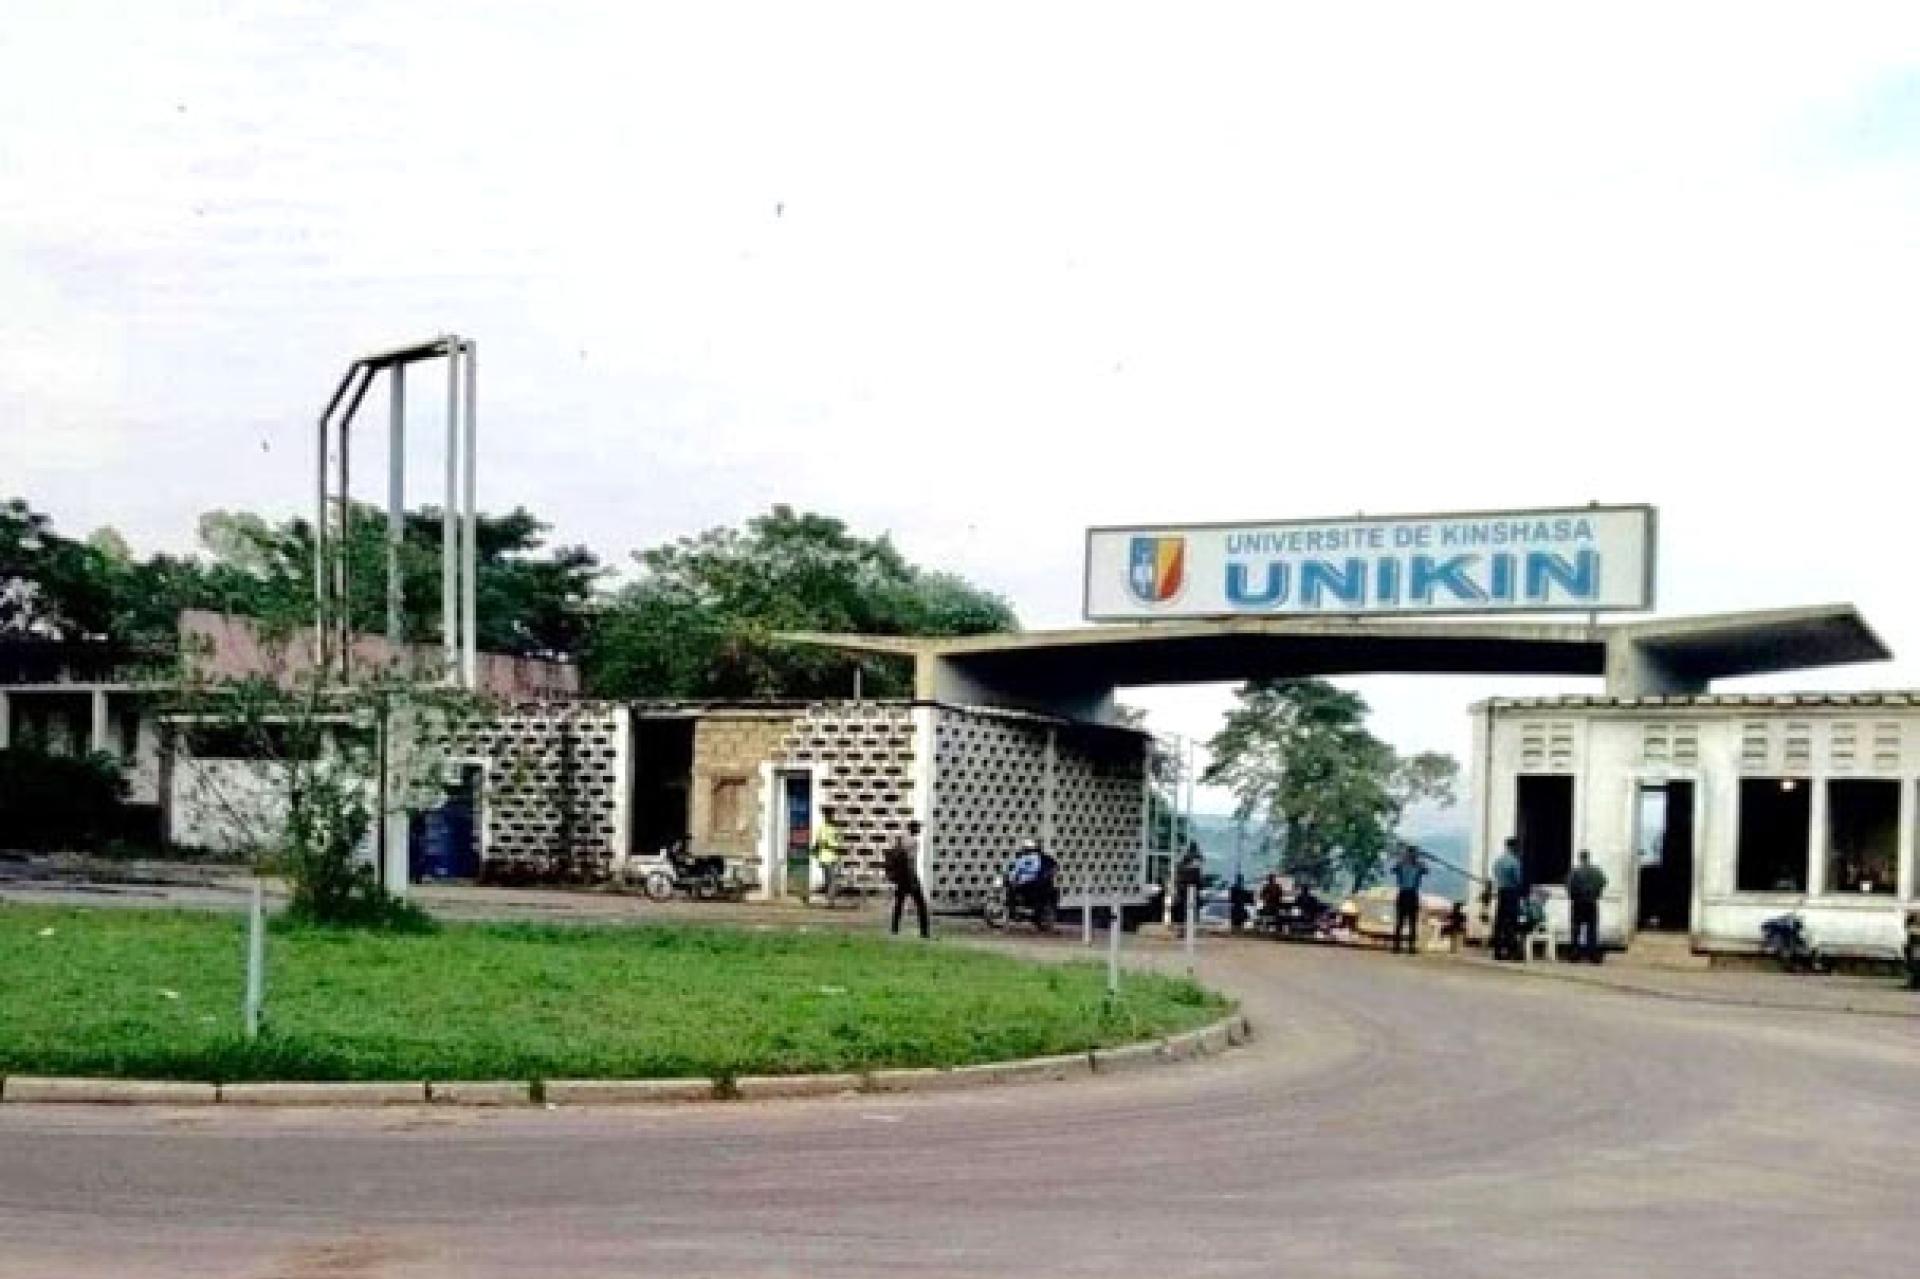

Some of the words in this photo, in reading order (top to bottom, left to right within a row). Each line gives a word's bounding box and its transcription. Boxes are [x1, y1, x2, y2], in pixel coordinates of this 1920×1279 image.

[1226, 527, 1385, 553] UNIVERSITE
[1394, 525, 1432, 547] DE
[1441, 518, 1594, 545] KINSHASA
[1225, 550, 1600, 608] UNIKIN
